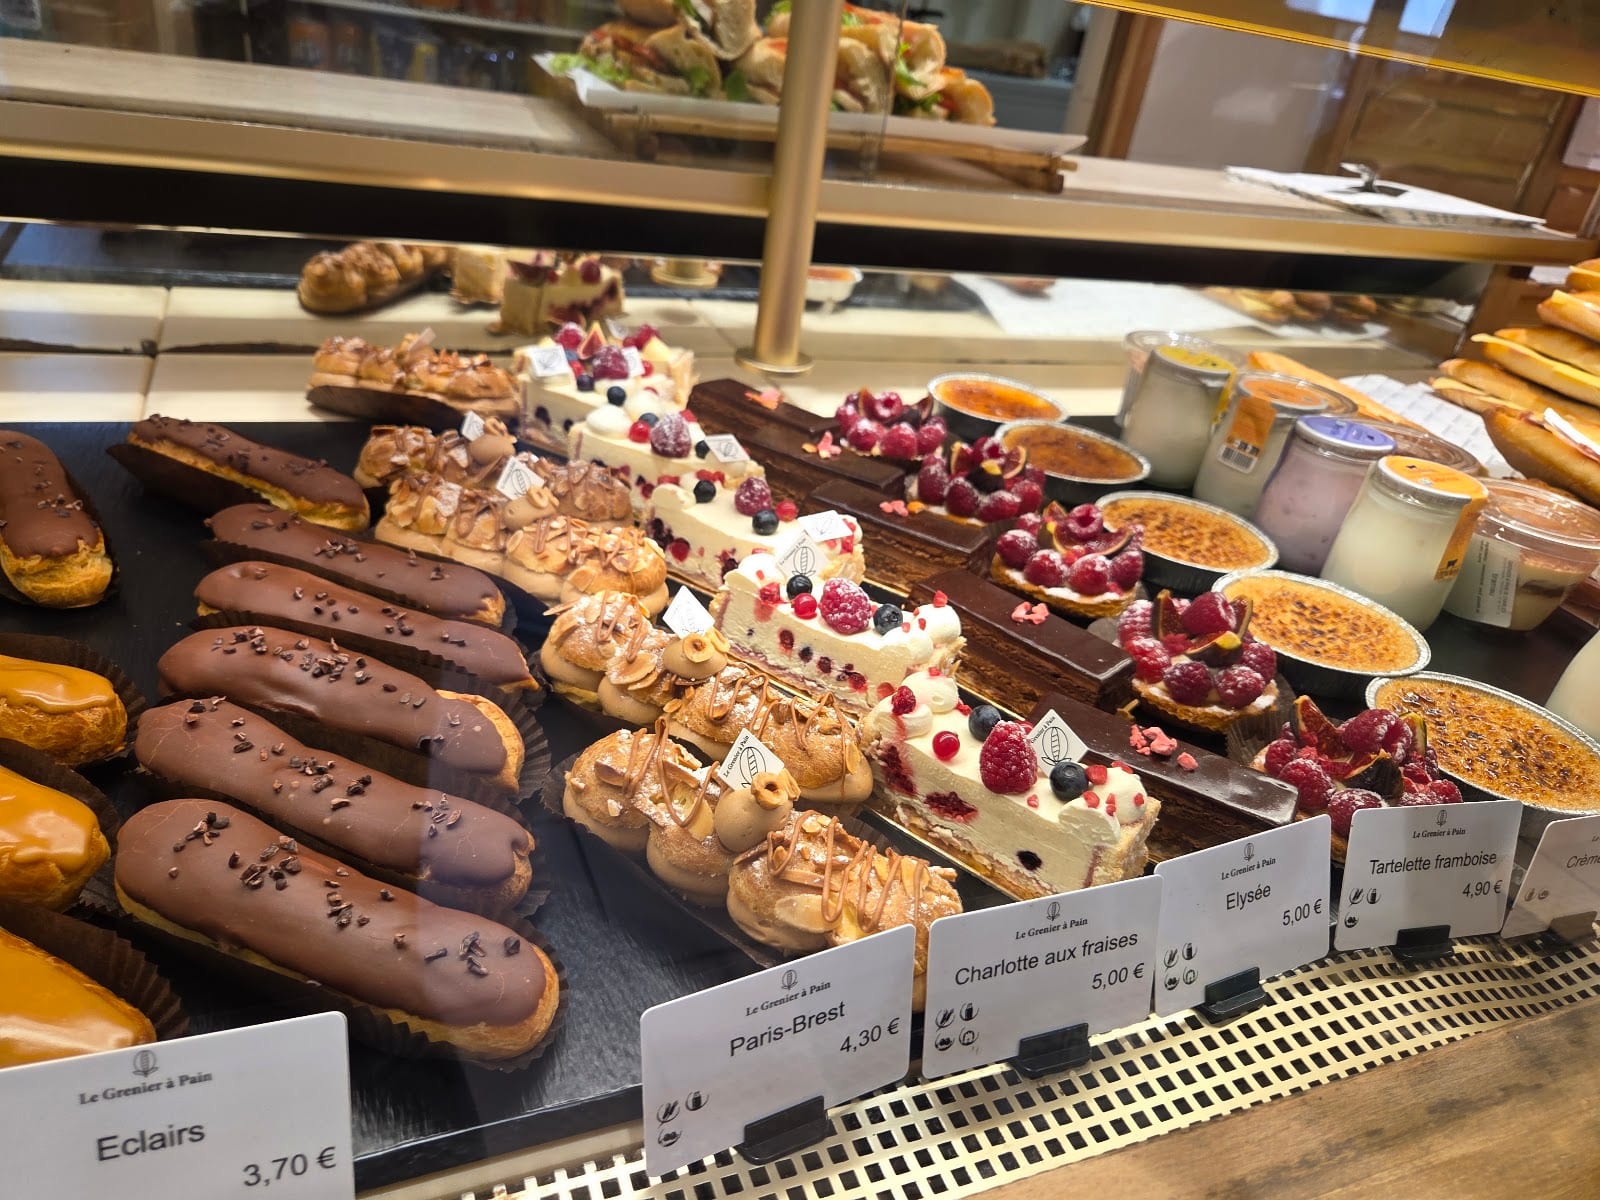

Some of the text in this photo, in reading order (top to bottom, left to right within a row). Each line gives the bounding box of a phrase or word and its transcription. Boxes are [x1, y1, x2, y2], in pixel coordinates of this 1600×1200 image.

[1421, 829, 1445, 839] Grenier
[1221, 872, 1230, 881] Le
[1230, 864, 1256, 878] Grenier
[1262, 857, 1276, 868] Pain
[1370, 851, 1497, 875] Tartelette framboise
[1226, 884, 1271, 911] Elysée
[1462, 879, 1503, 899] 4,90 €
[1282, 898, 1322, 927] 5,00 €
[1015, 917, 1088, 940] Le Grenier à Pain
[955, 932, 1138, 985] Charlotte aux fraises
[1092, 962, 1145, 991] 5,00 €
[746, 980, 831, 1017] Le Grenier à Pain
[729, 1001, 846, 1057] Paris-Brest
[839, 1017, 900, 1053] 4,30 €
[78, 1070, 213, 1105] Le Grenier à Pain
[97, 1124, 206, 1162] Eclairs
[243, 1146, 337, 1187] 3,70 €
